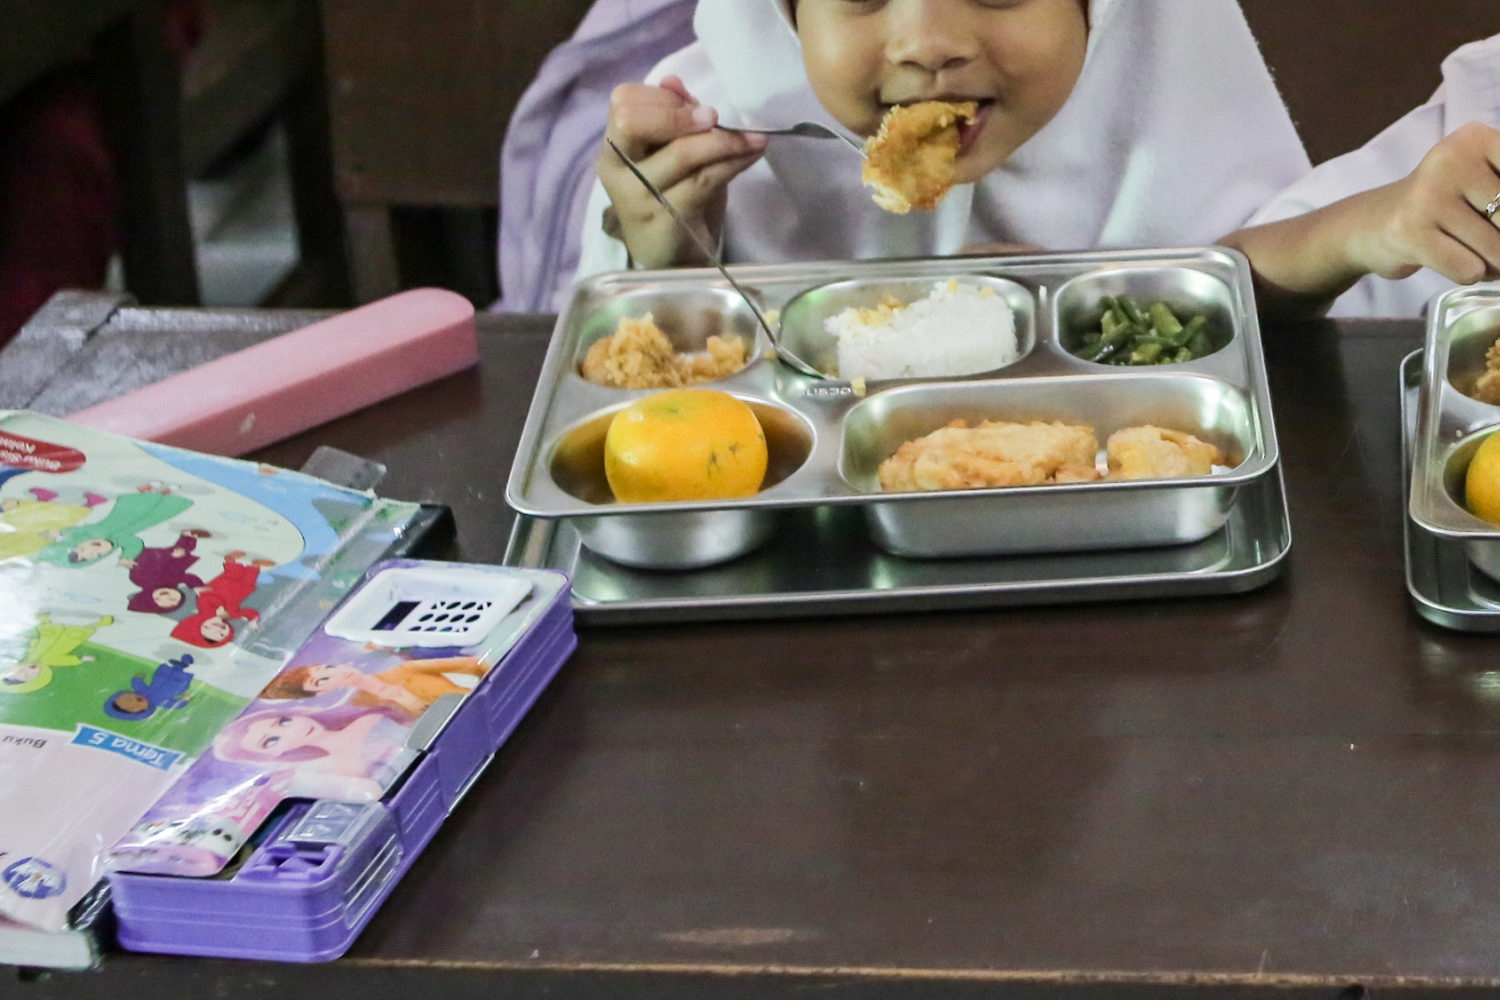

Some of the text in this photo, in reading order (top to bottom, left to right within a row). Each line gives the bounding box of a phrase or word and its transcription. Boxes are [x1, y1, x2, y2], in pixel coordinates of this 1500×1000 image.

[2, 735, 48, 750] Buku
[87, 731, 165, 767] Tema 5
